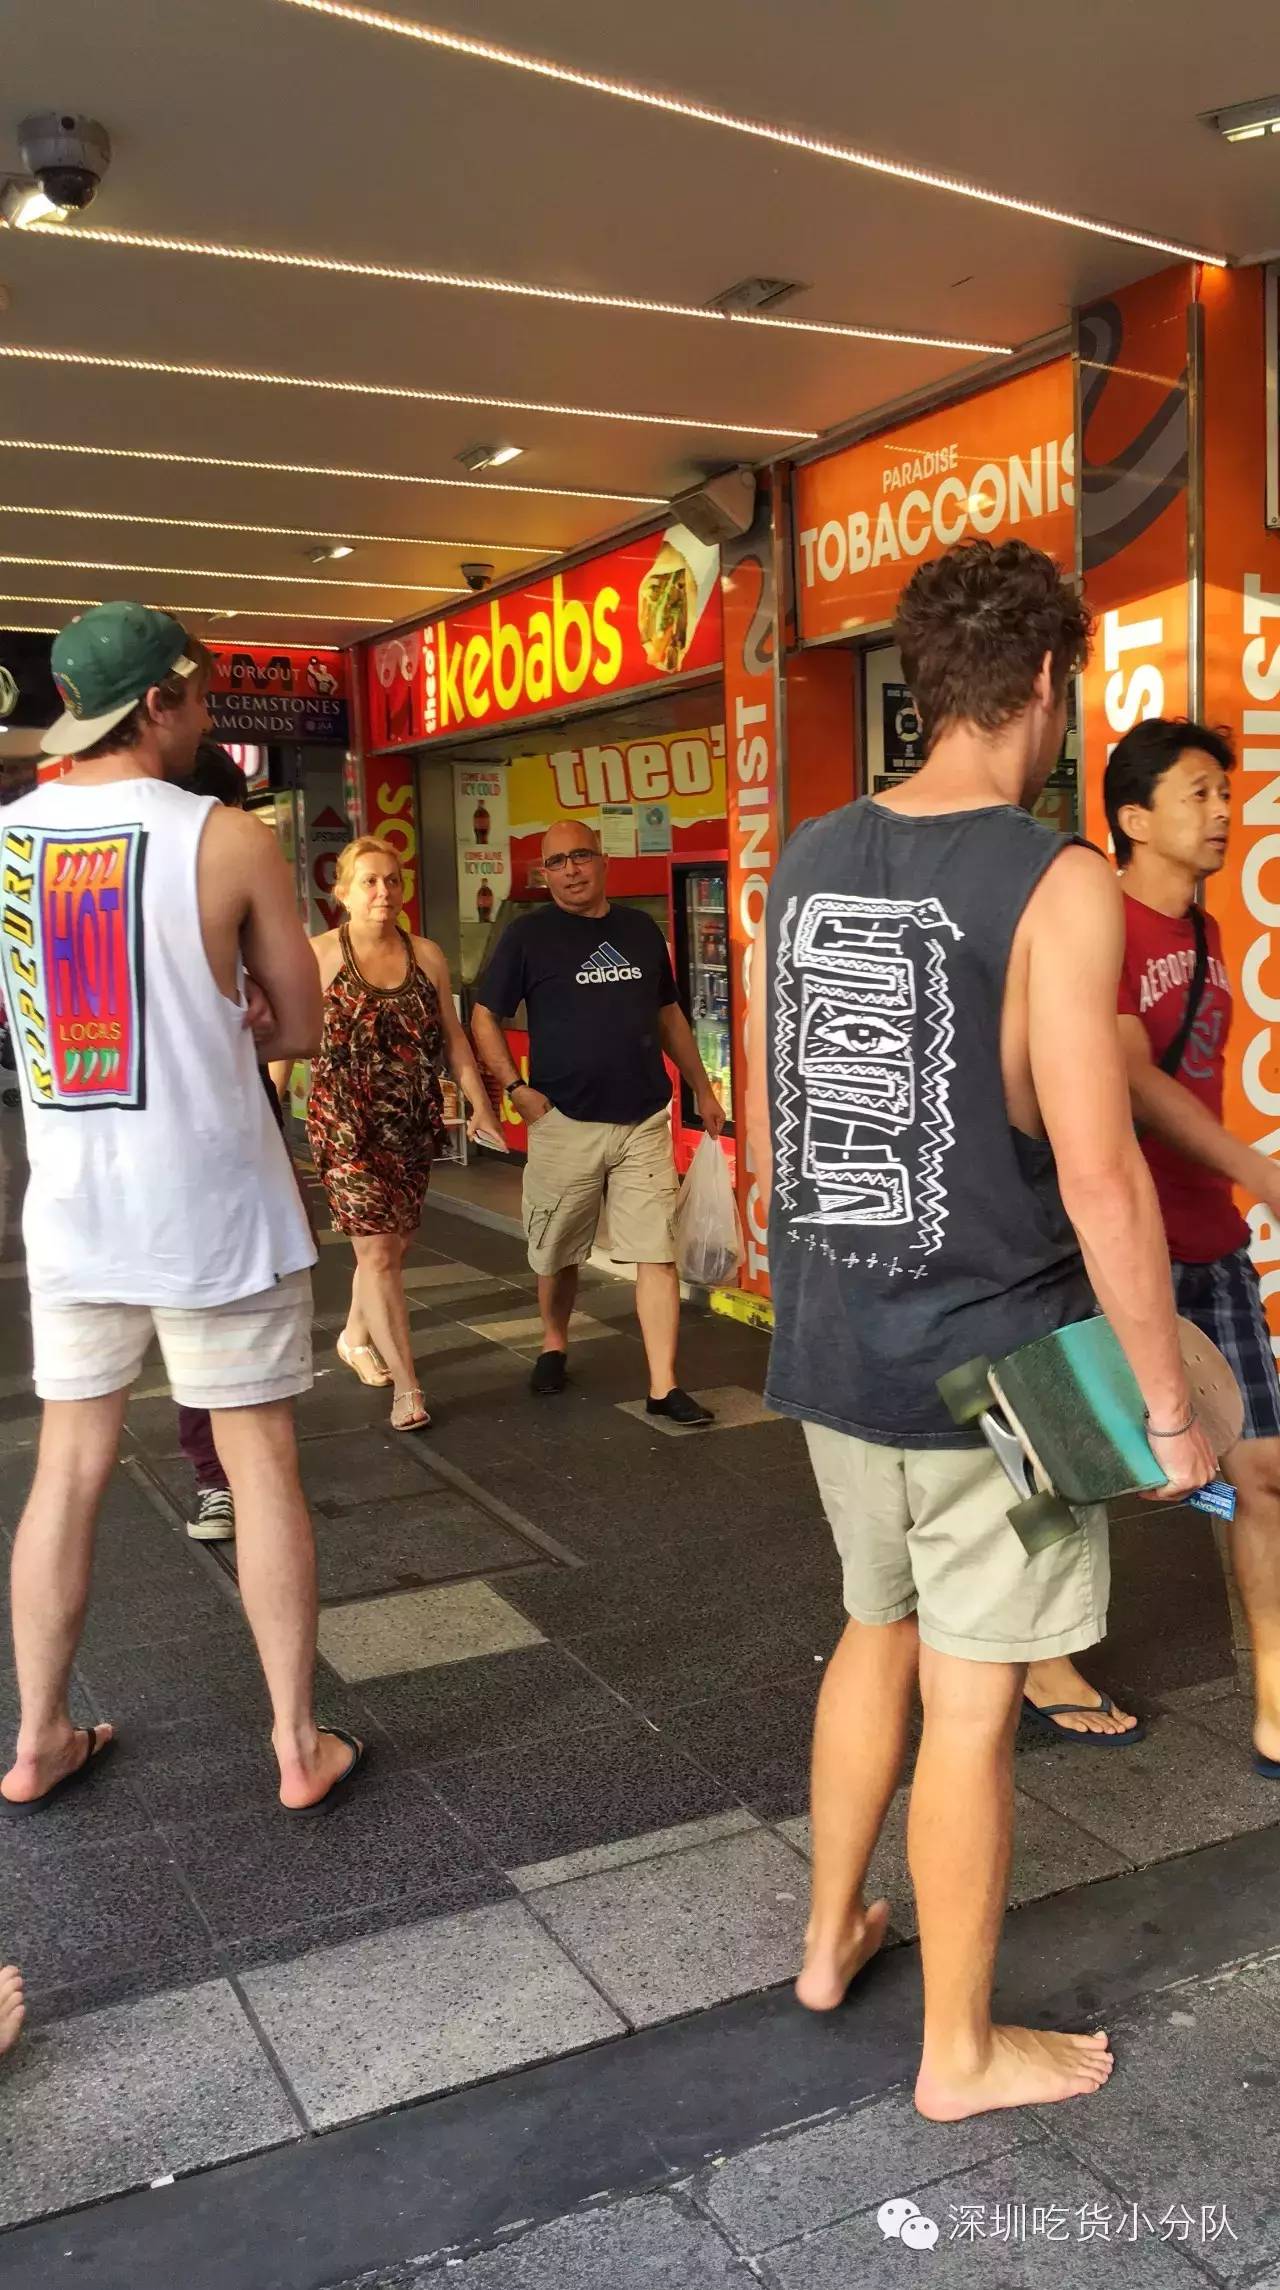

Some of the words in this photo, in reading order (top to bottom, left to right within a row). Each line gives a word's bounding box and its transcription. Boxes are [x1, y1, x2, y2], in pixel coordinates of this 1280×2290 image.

[883, 443, 959, 494] PARADISE
[438, 573, 623, 728] kebabs
[216, 664, 299, 681] WORKOUT
[226, 694, 341, 715] GEMSTONES
[50, 888, 119, 1017] HOT
[576, 965, 643, 985] adidas
